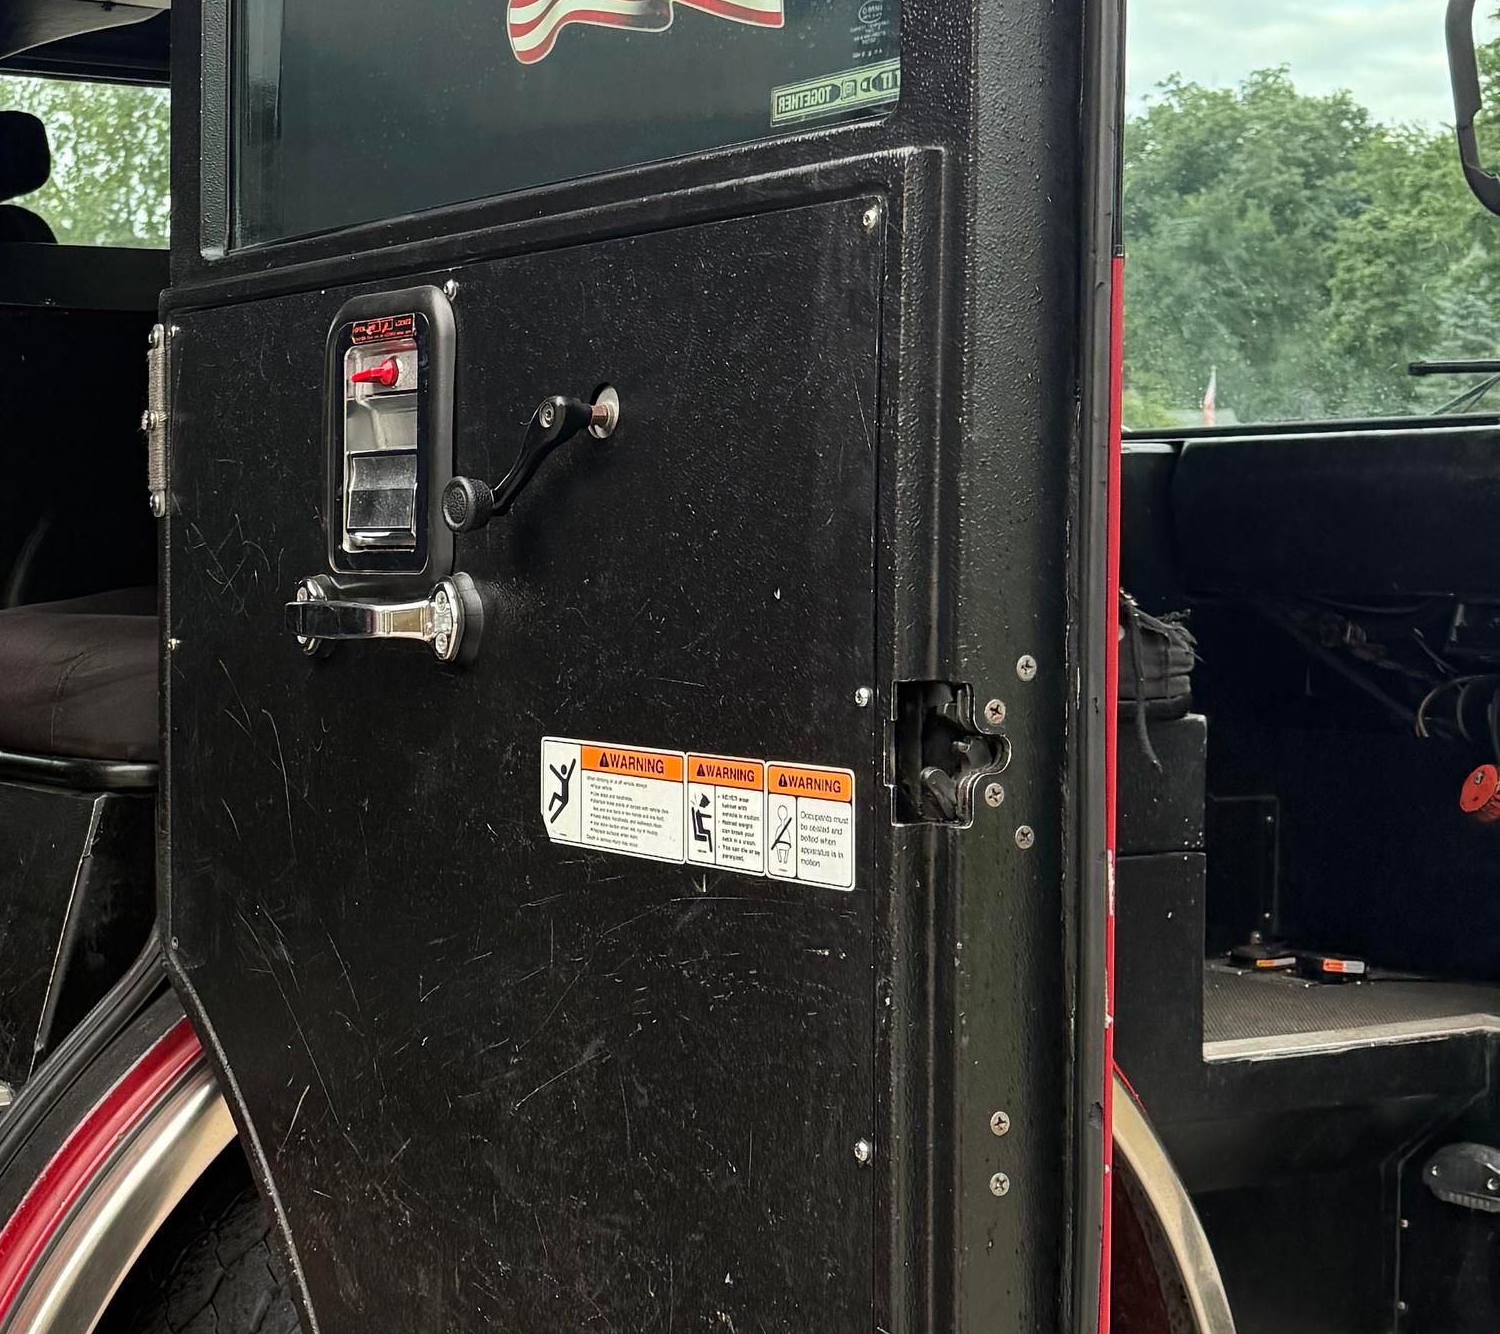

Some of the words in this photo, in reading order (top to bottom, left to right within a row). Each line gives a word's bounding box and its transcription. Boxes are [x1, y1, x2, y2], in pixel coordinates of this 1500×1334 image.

[610, 753, 664, 774] WARNING
[706, 764, 755, 782] WARNING
[788, 775, 841, 793] WARNING
[831, 827, 843, 836] and
